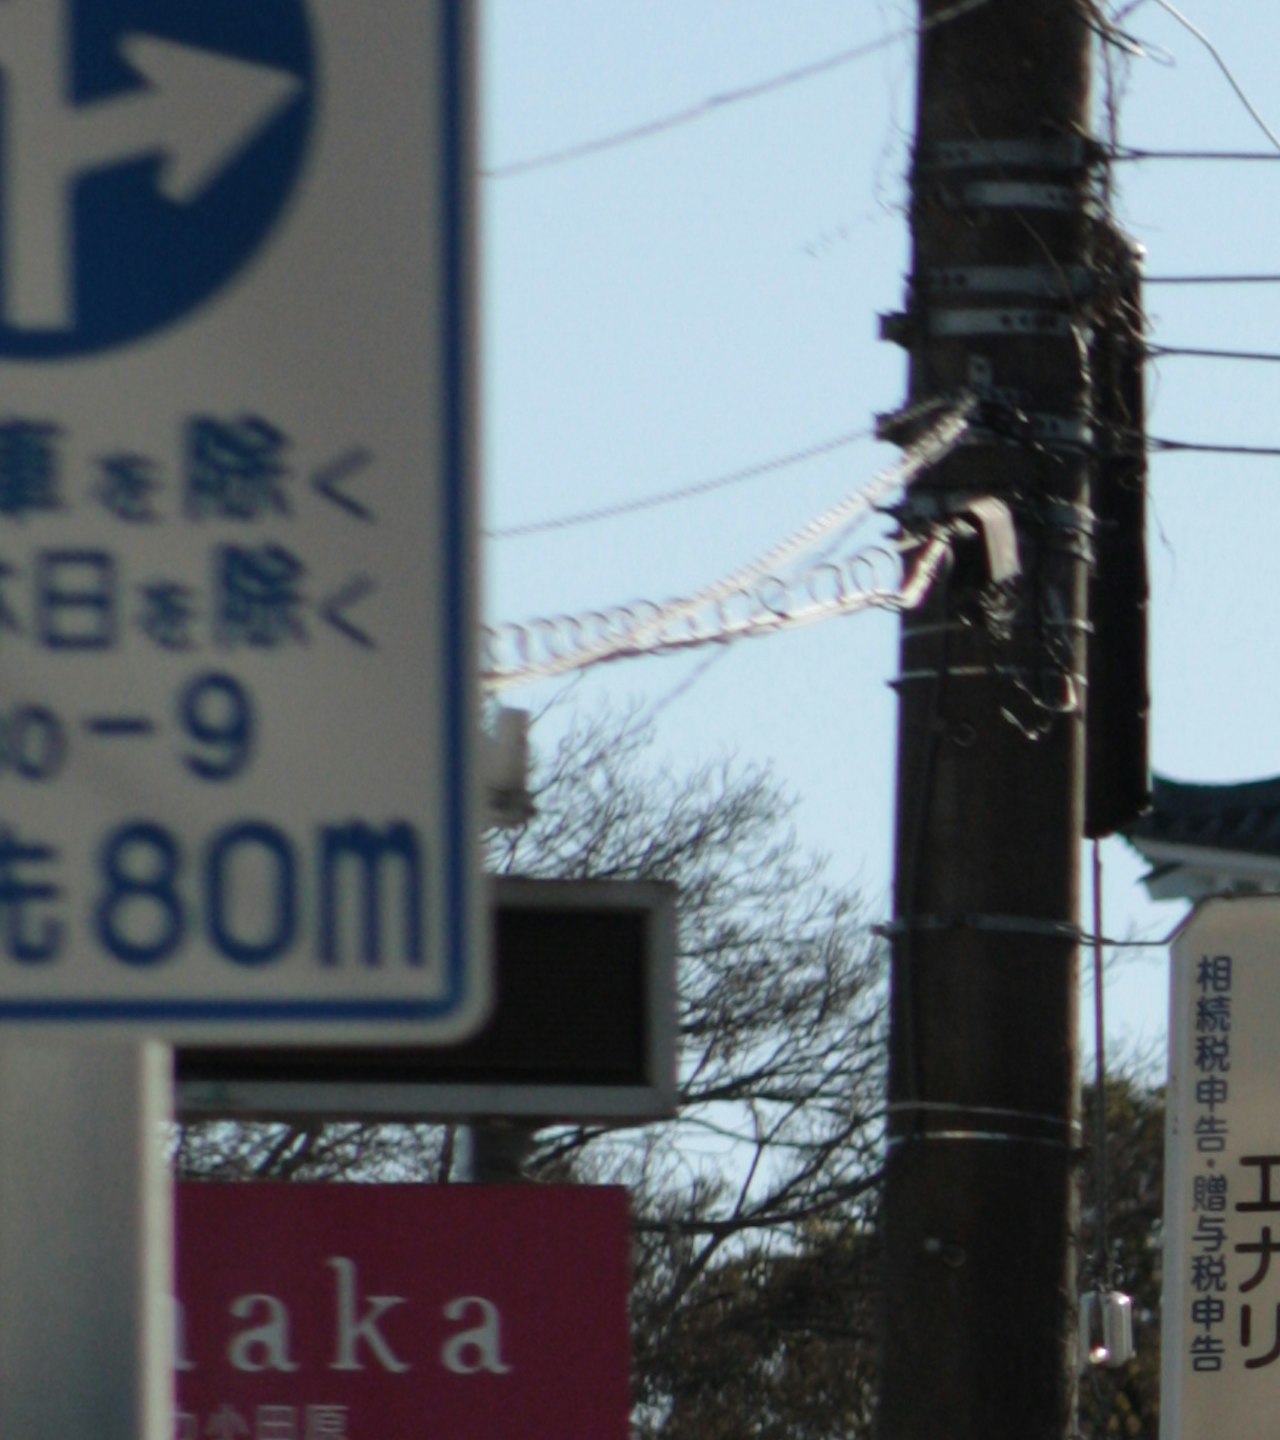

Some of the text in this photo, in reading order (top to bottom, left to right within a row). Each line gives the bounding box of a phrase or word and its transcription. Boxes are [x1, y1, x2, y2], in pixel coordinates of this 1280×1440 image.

[0, 541, 378, 652] 日を除く
[1188, 955, 1233, 1373] 相続税申告・贈与税申告
